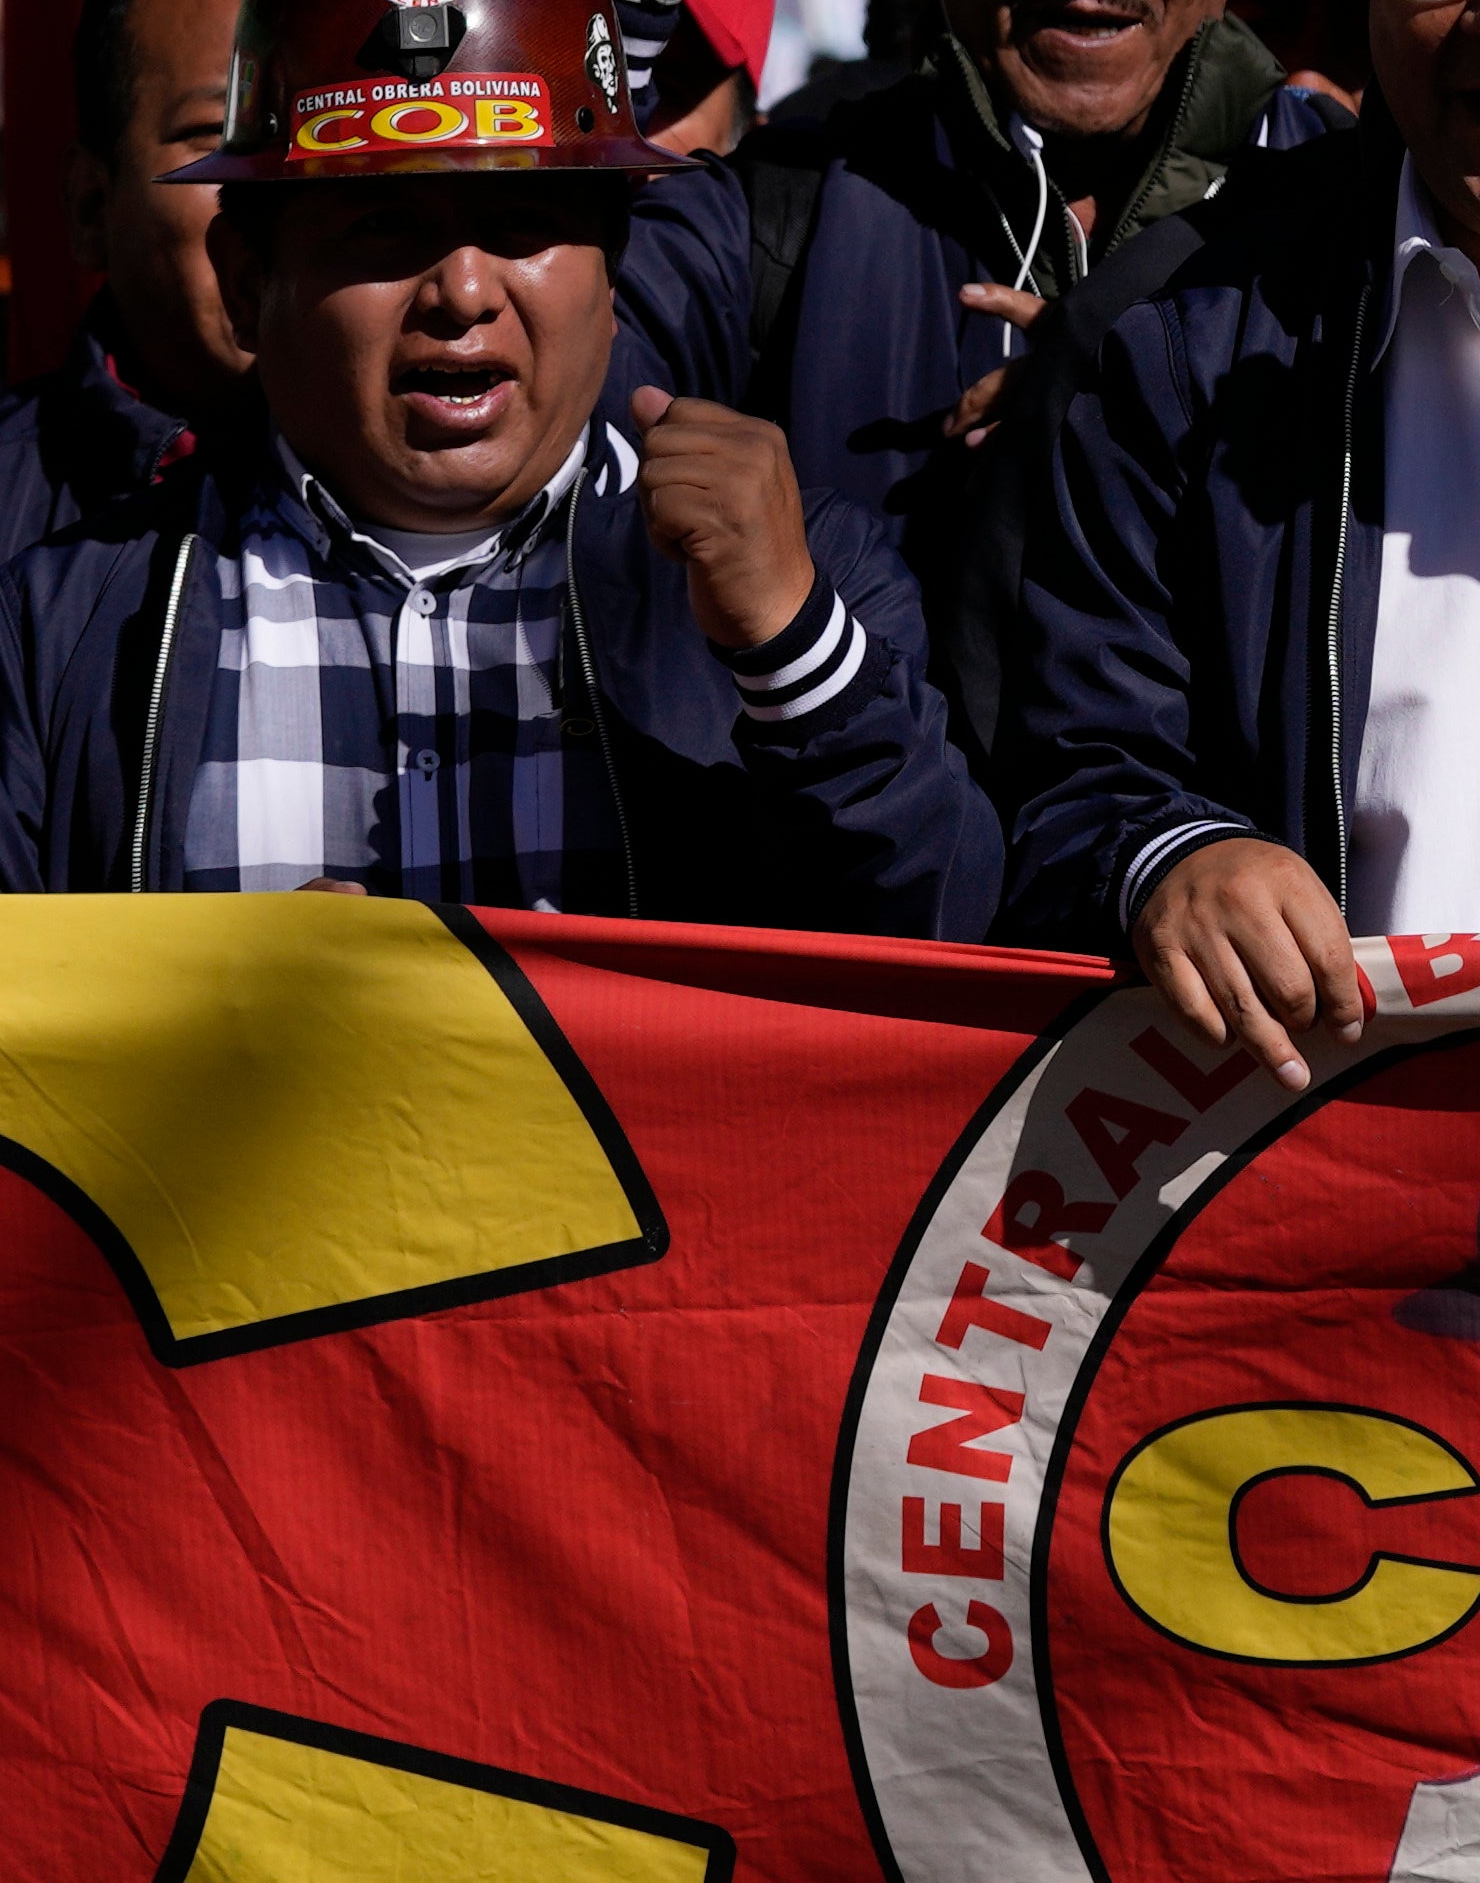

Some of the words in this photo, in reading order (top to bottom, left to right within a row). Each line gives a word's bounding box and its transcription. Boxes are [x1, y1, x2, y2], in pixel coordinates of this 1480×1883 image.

[296, 87, 366, 114] CENTRAL
[371, 81, 444, 102] OBRERA
[450, 80, 541, 98] BOLIVIANA
[296, 99, 545, 152] COB
[901, 1026, 1262, 1689] CENTRAL
